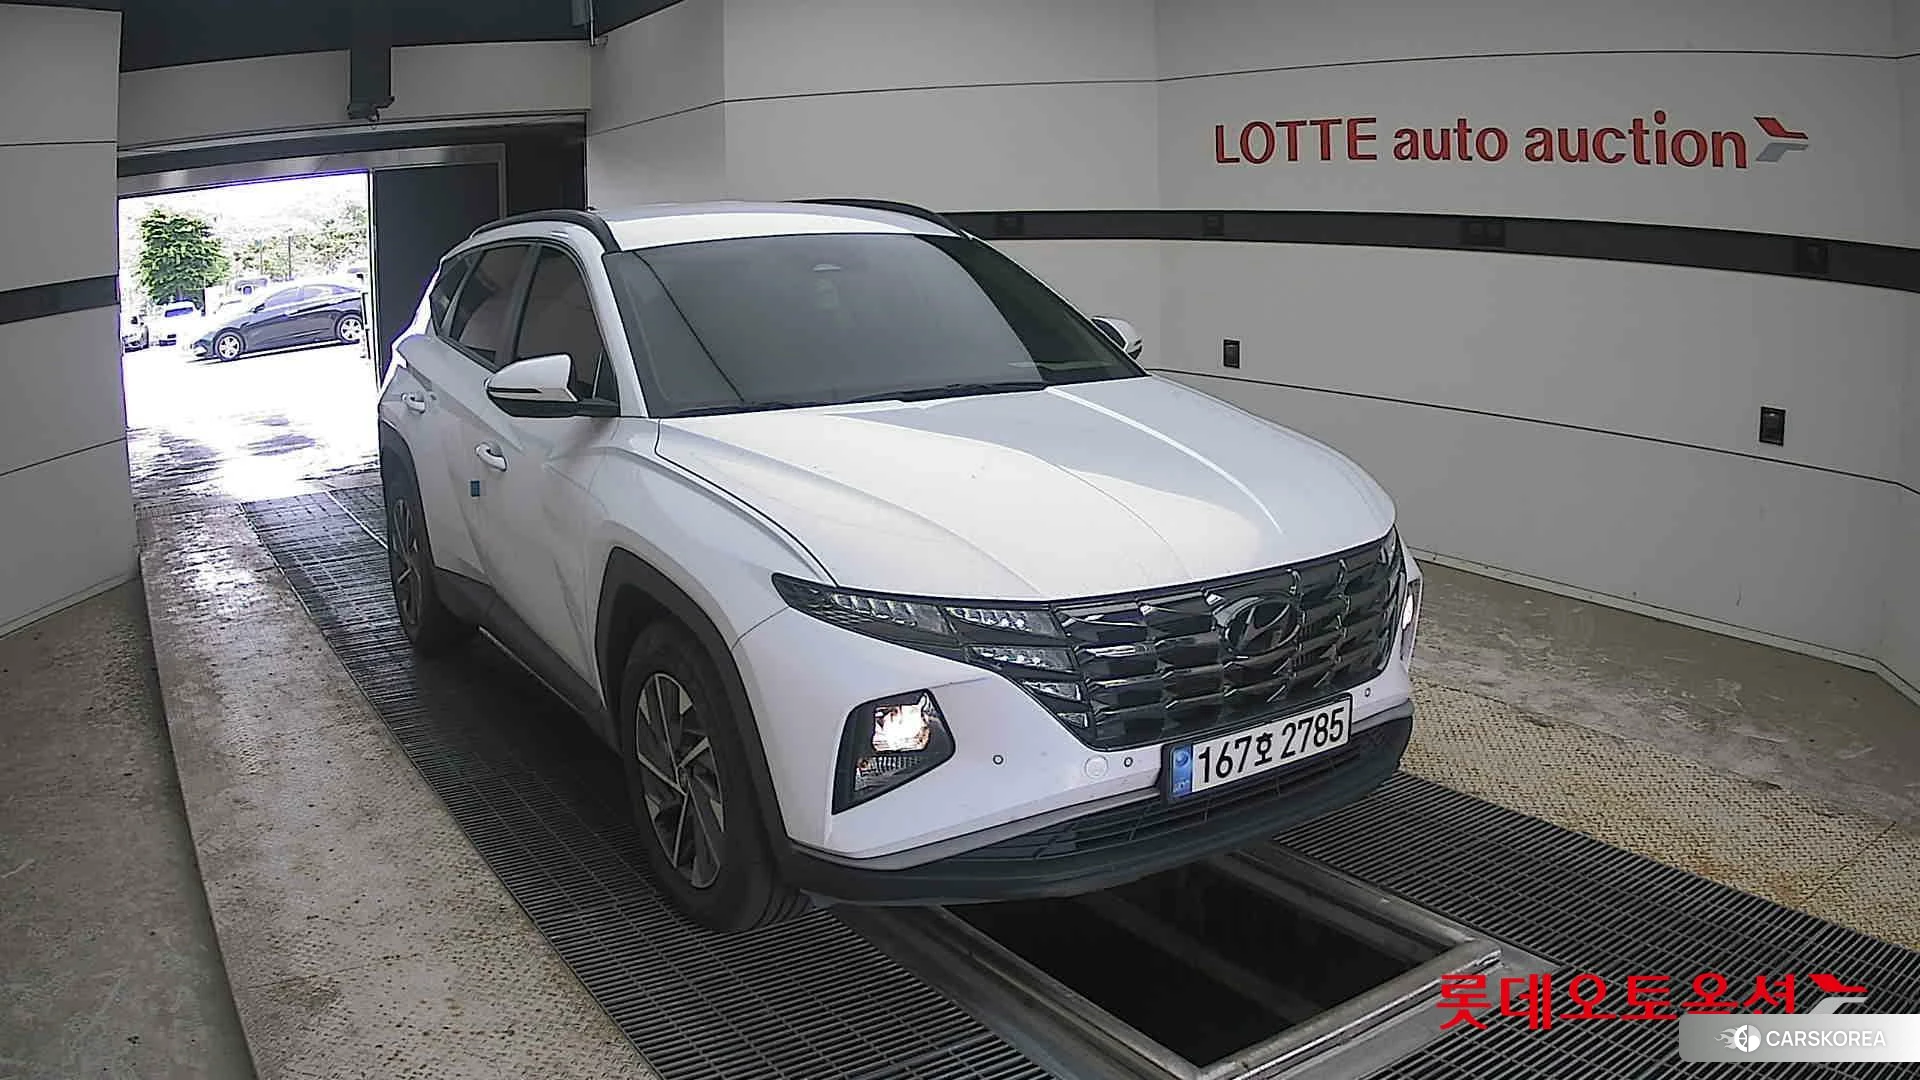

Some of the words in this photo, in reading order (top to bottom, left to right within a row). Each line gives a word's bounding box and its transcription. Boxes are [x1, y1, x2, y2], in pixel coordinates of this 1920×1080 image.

[1215, 117, 1377, 163] LOTTE
[1392, 118, 1508, 162] auto
[1524, 110, 1748, 168] auction
[1198, 732, 1273, 783] 167호
[1280, 706, 1345, 759] 2785
